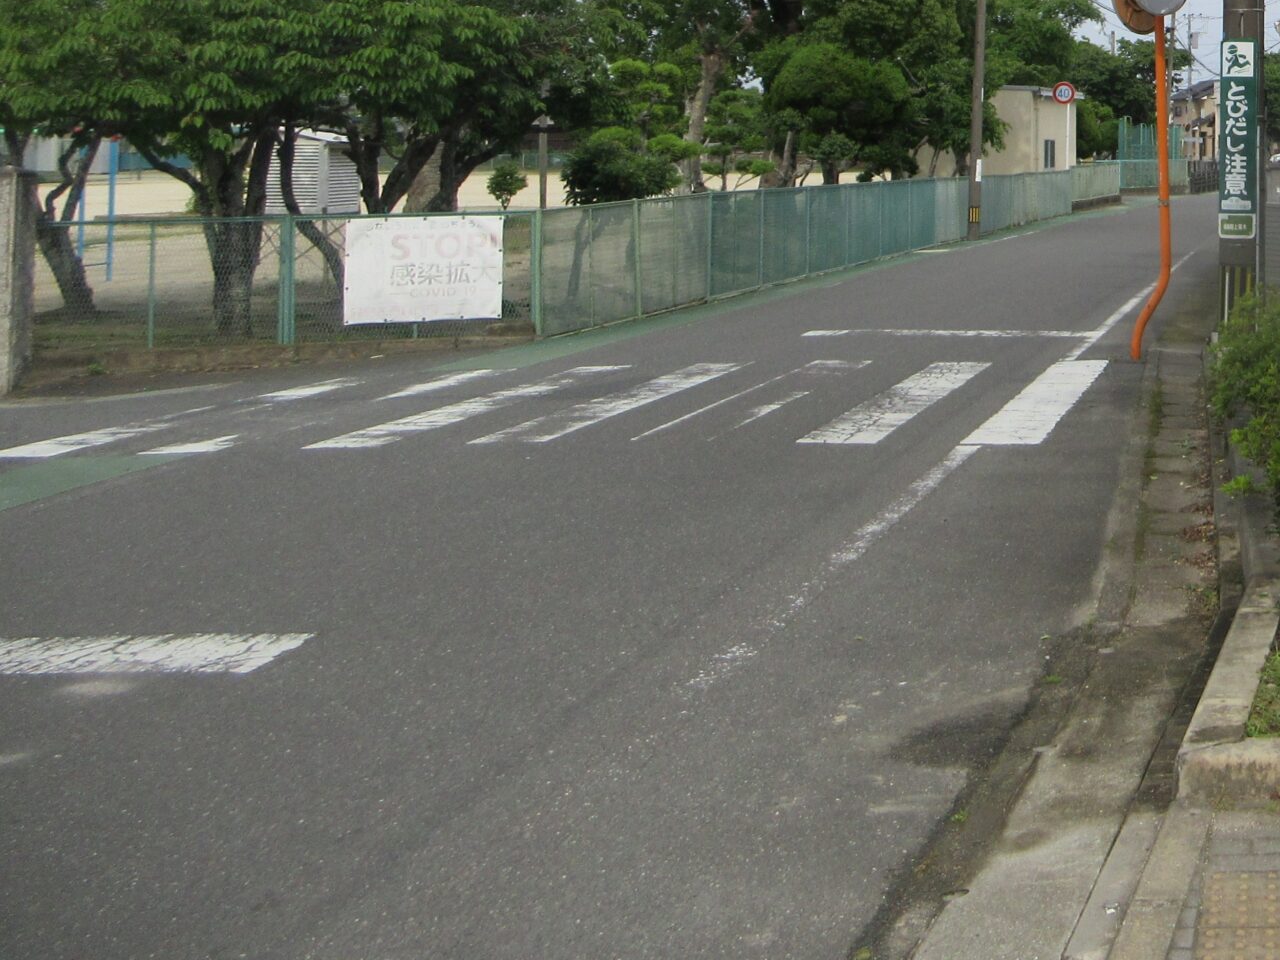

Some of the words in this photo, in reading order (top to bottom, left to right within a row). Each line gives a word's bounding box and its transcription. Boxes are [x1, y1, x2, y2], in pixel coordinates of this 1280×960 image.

[1058, 88, 1070, 99] 40
[1225, 81, 1248, 195] とびだし注意
